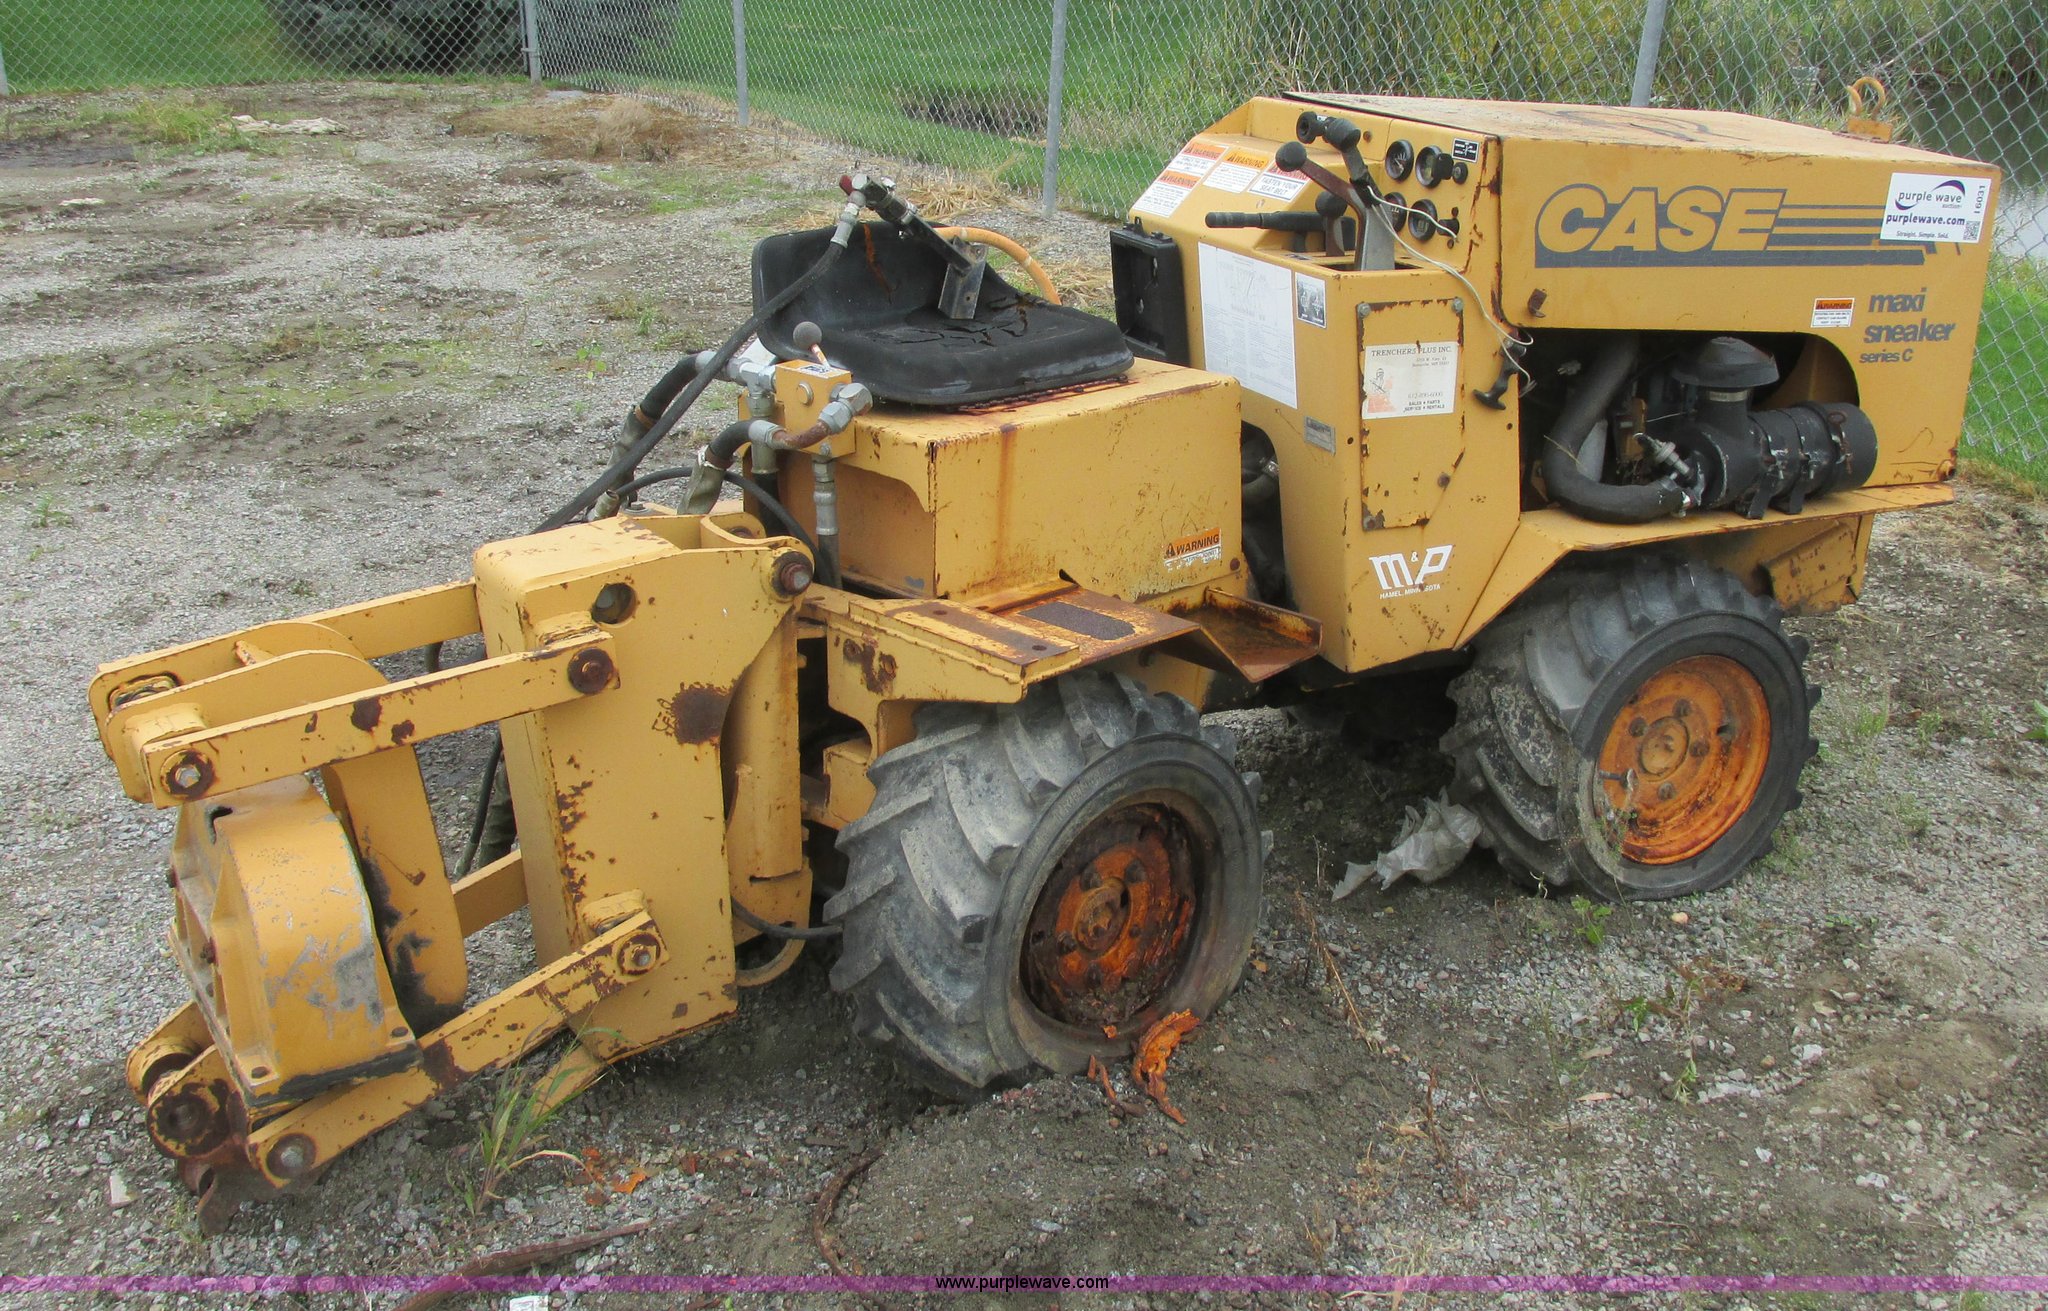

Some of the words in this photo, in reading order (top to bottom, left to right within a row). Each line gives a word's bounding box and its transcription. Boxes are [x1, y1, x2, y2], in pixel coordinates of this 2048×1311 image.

[1233, 153, 1265, 168] WARNING
[1262, 177, 1281, 187] FASTEN
[1282, 180, 1299, 190] YOUR
[1898, 191, 1932, 203] purple
[1935, 195, 1962, 203] wave
[1974, 185, 1985, 214] 16031
[1536, 184, 1787, 253] CASE
[1886, 213, 1966, 226] purplewave.com
[1868, 287, 1927, 313] maxi
[1863, 318, 1956, 344] sneaker
[1371, 348, 1416, 357] TRENCHERS
[1417, 346, 1437, 354] PLUS
[1859, 349, 1900, 364] series
[1902, 348, 1913, 362] C
[1176, 533, 1220, 556] WARNING
[1404, 584, 1441, 595] MINNSOTA
